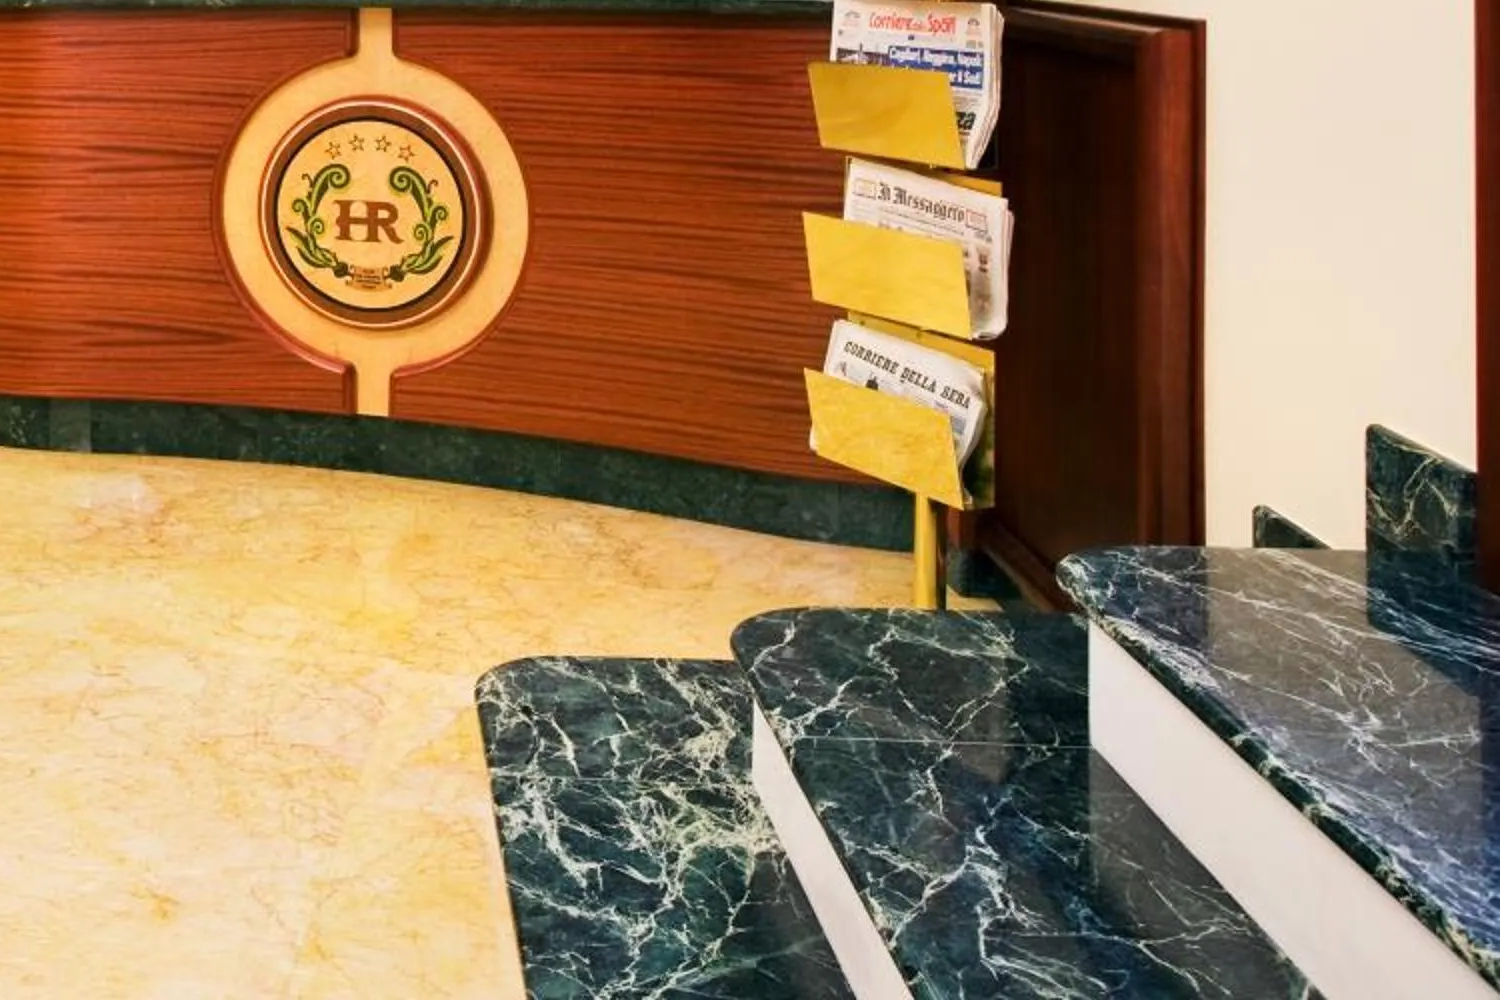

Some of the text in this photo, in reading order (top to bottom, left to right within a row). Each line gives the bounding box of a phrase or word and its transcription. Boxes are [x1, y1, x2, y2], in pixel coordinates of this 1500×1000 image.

[869, 12, 913, 30] Corriere
[333, 199, 405, 245] HR
[894, 186, 965, 222] Messaggero
[843, 341, 900, 375] CORRIERE
[900, 366, 937, 393] DELLA
[940, 385, 971, 409] SERA
